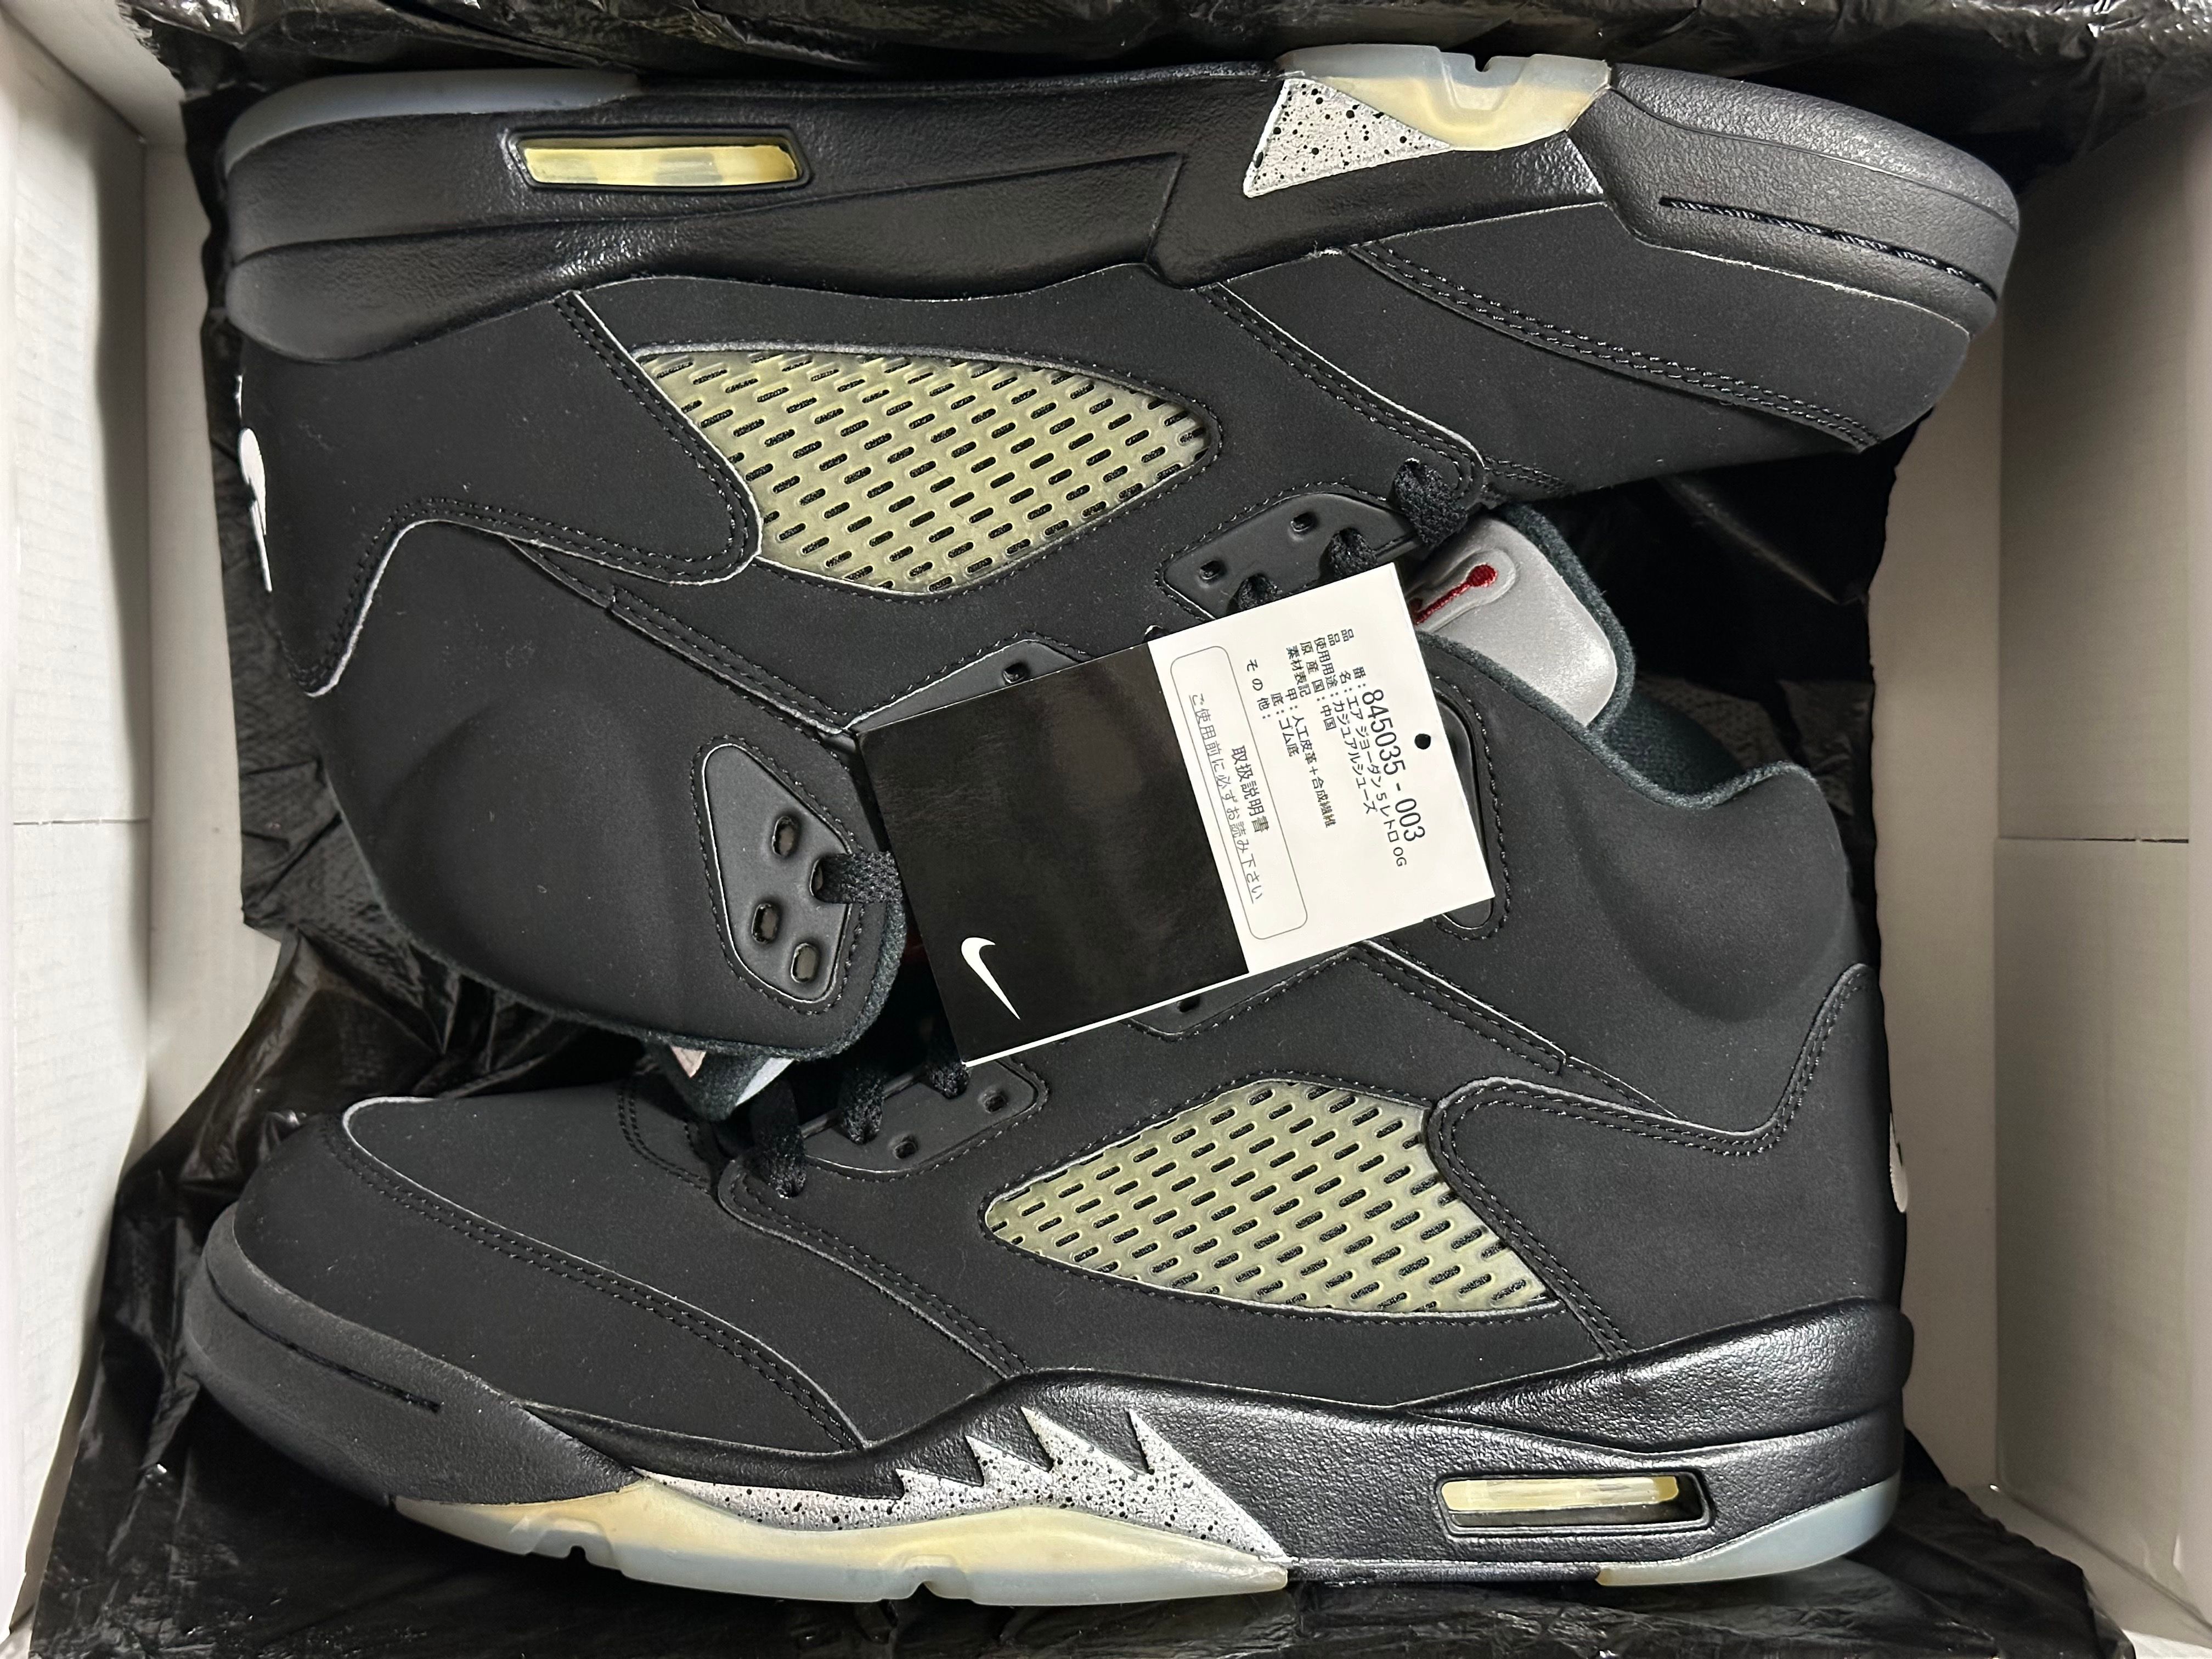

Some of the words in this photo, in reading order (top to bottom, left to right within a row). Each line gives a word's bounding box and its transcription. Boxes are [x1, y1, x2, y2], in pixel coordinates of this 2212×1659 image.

[1285, 644, 1312, 698] 素材表記
[1278, 716, 1300, 757] ゴム底
[1319, 704, 1337, 731] 中国
[1191, 693, 1262, 899] ご使用前に必ずお読み下さい
[1230, 744, 1269, 833] 取扱説明書
[1355, 725, 1381, 788] ジョーダン
[1379, 804, 1400, 843] レトロ
[1392, 846, 1407, 867] OG
[1361, 689, 1406, 775] 845035
[1394, 797, 1426, 842] 003
